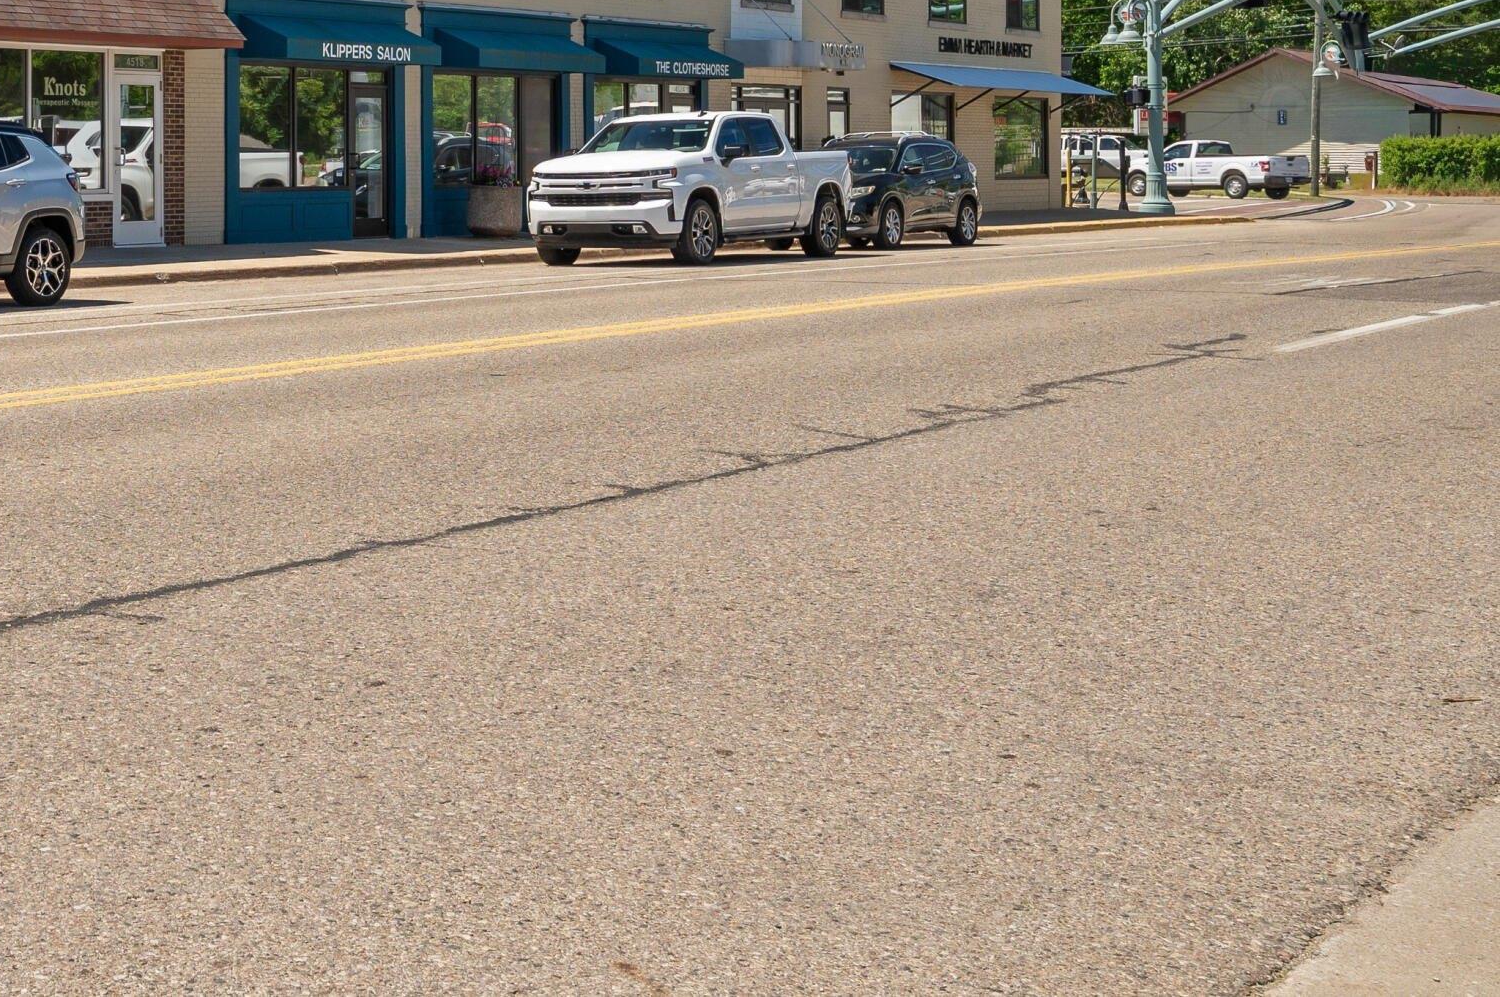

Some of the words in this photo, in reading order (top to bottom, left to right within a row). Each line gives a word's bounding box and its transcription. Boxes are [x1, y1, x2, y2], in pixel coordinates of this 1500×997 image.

[322, 42, 372, 59] KLIPPERS
[377, 46, 411, 61] SALON
[938, 36, 963, 54] EMMA
[964, 38, 995, 56] HEARTH
[1002, 42, 1033, 59] MARKET
[655, 60, 671, 74] THE
[672, 61, 730, 76] CLOTHESHORSE
[43, 76, 86, 97] Knots
[1163, 162, 1178, 172] BS
